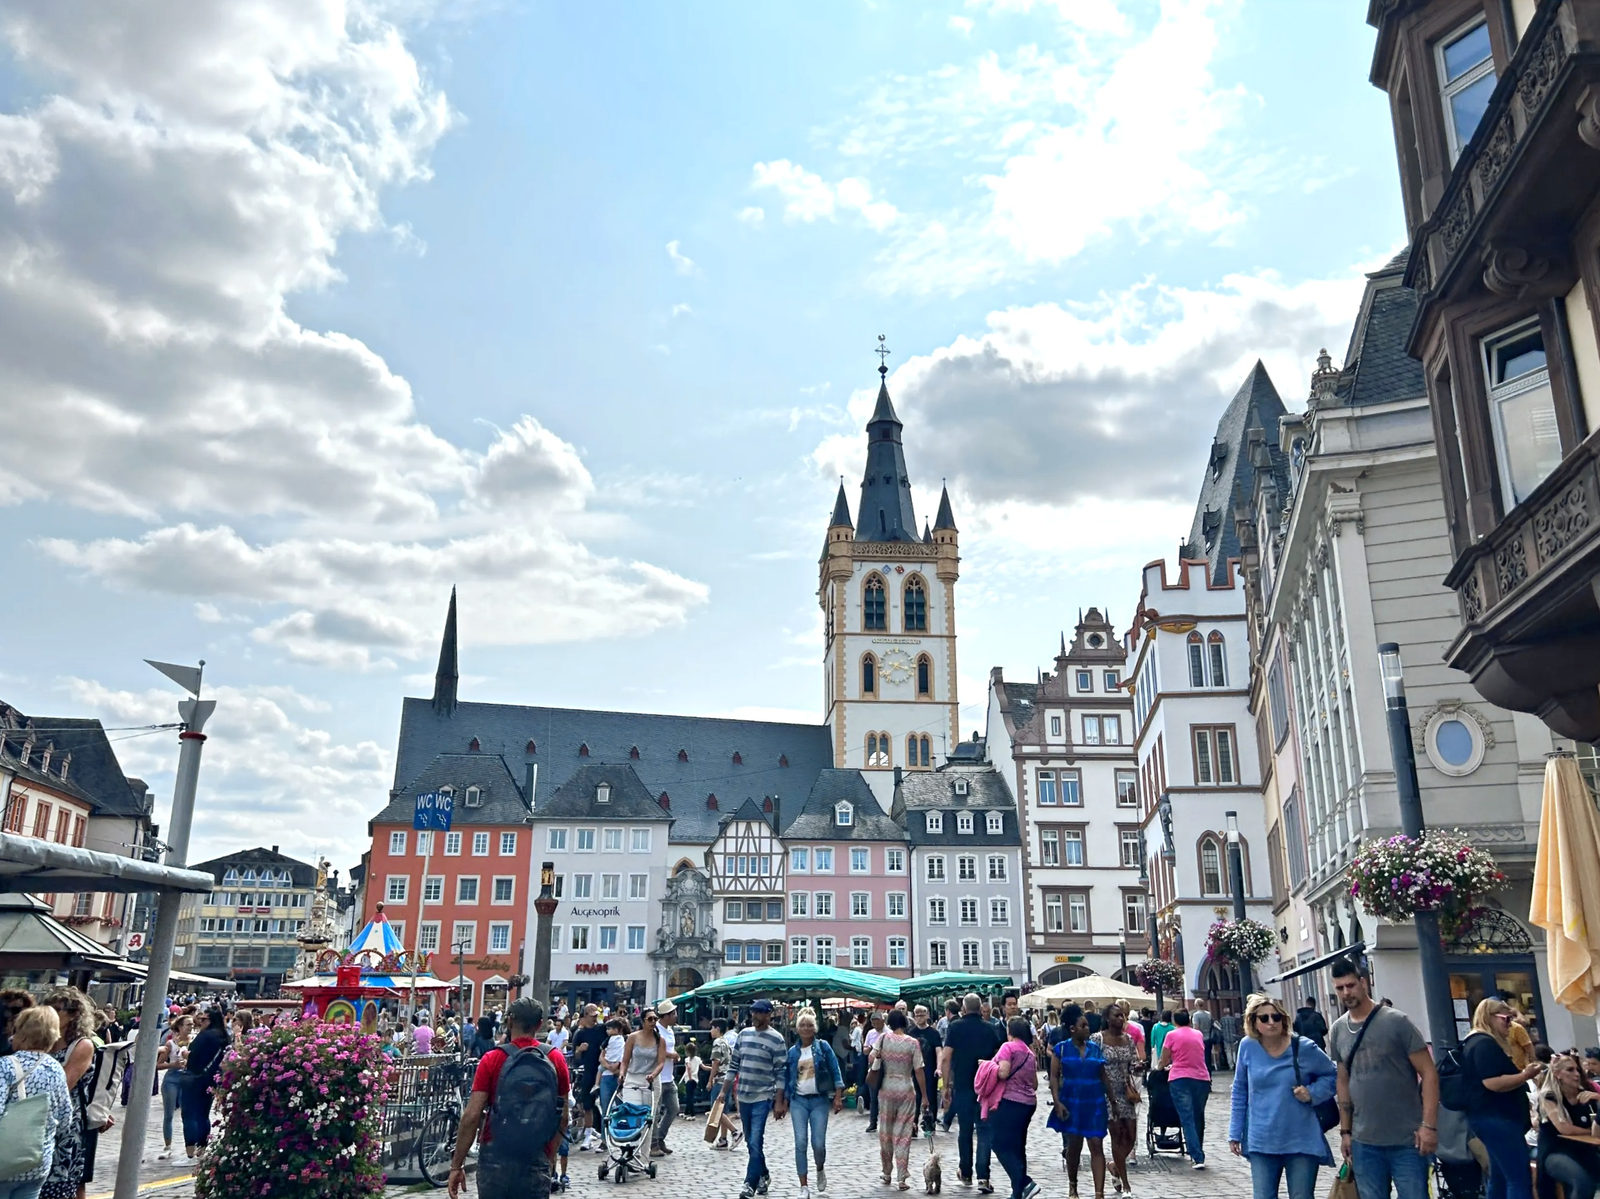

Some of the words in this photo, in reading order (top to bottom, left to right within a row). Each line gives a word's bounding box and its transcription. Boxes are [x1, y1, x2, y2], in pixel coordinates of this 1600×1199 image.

[417, 794, 433, 809] WC
[435, 794, 451, 811] WC
[128, 934, 142, 947] A
